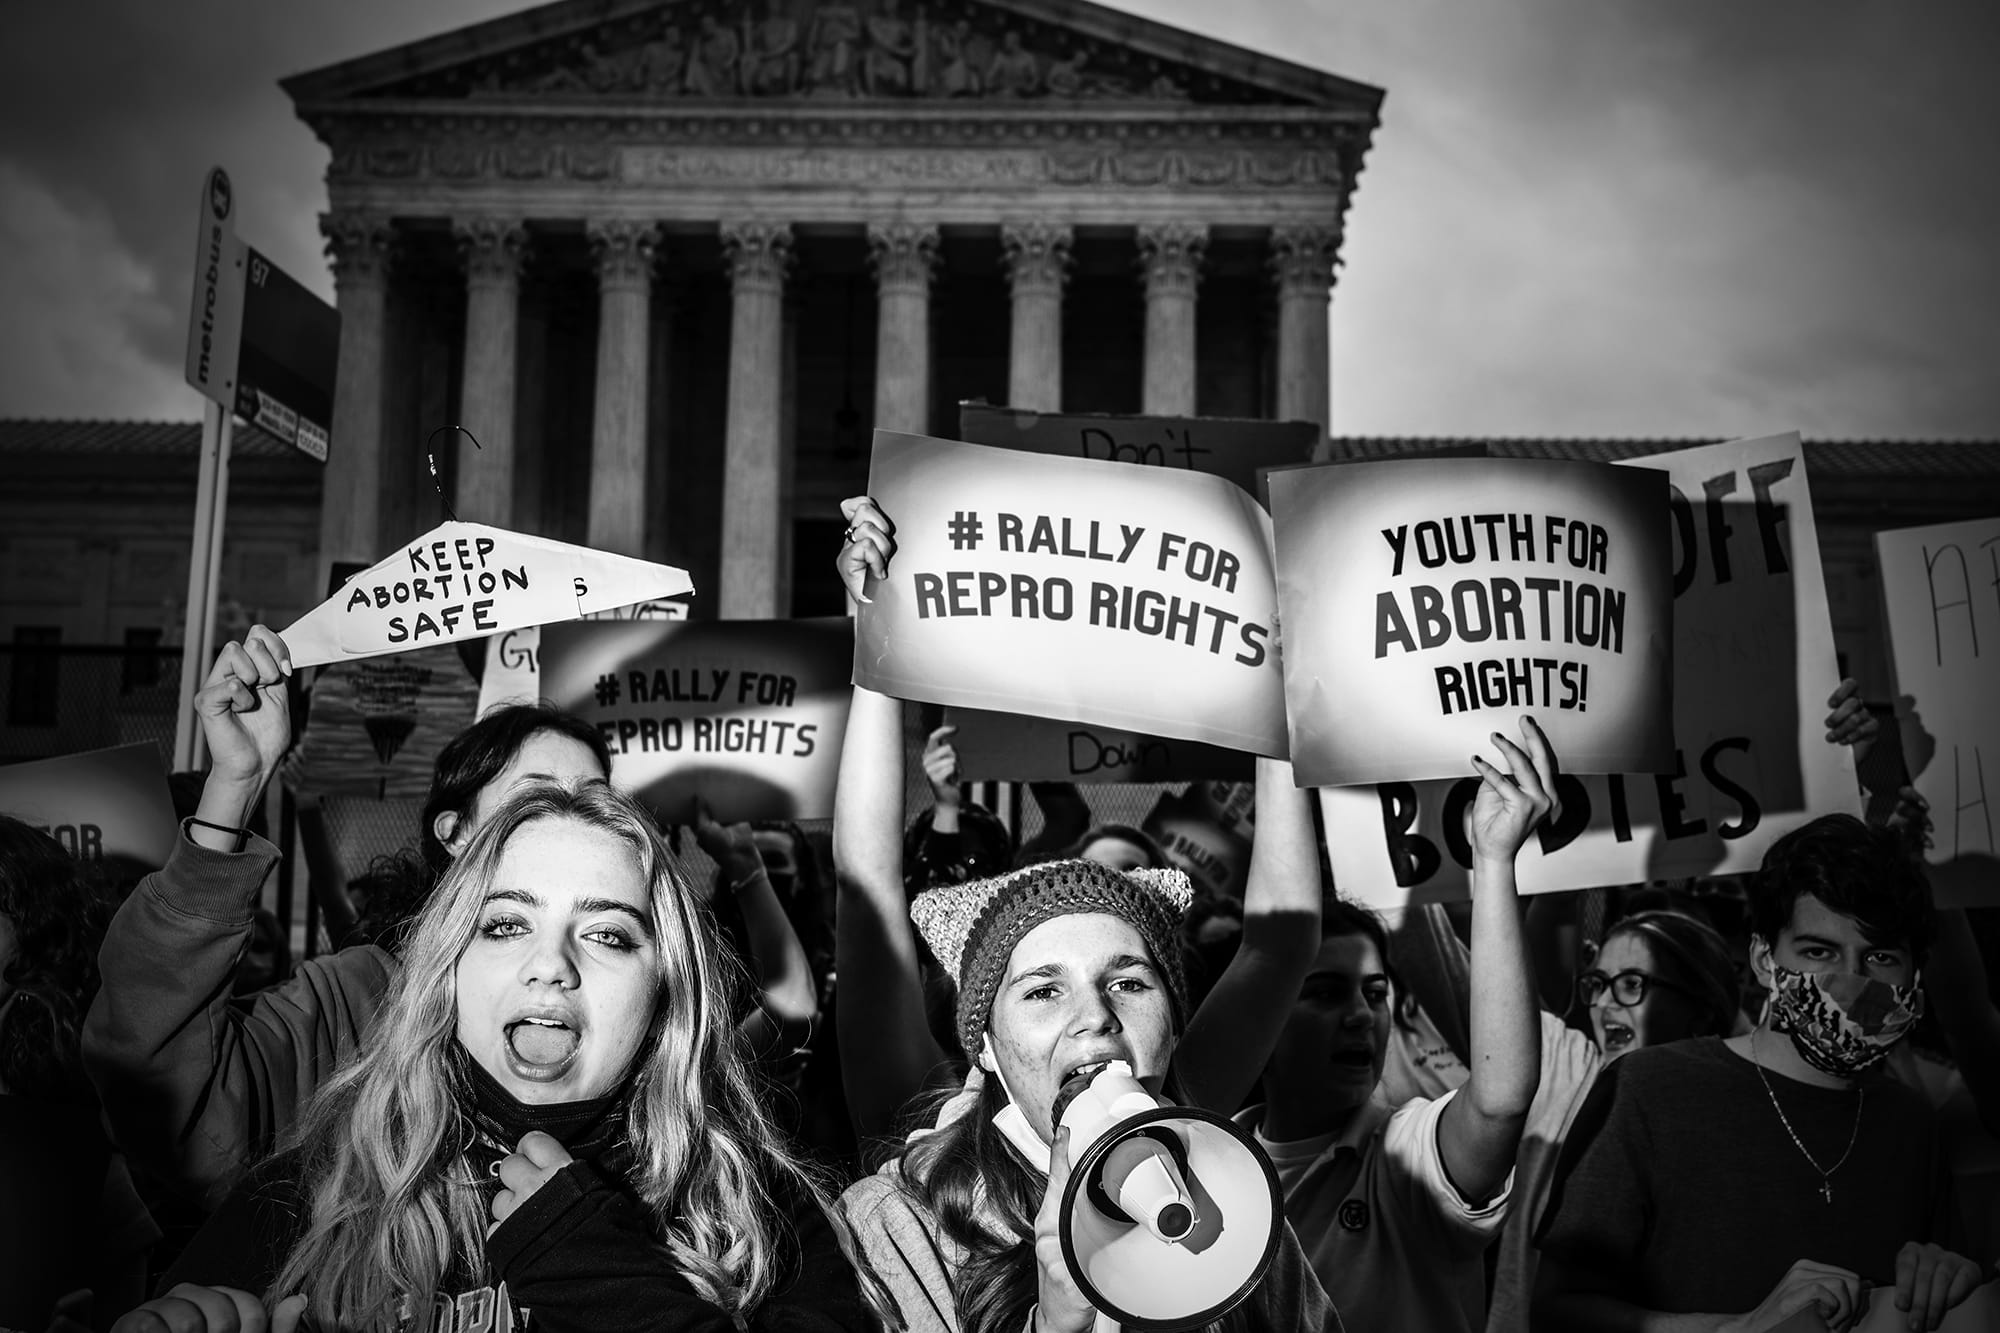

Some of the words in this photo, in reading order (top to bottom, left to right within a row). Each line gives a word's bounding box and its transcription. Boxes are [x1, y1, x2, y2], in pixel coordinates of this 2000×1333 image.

[250, 258, 270, 288] 97
[200, 223, 222, 383] metrobus
[408, 537, 495, 573] KEEP
[948, 511, 984, 551] #
[997, 512, 1146, 564] RALLY
[1156, 532, 1241, 594] FOR
[1381, 513, 1536, 577] YOUTH
[1545, 515, 1609, 575] FOR
[346, 565, 529, 613] ABORTION
[388, 599, 498, 643] SAFE
[913, 571, 1074, 621] REPRO
[1089, 582, 1269, 668] RIGHTS
[1374, 577, 1627, 660] ABORTION
[596, 674, 620, 706] #
[628, 669, 730, 704] RALLY
[738, 671, 798, 707] FOR
[1434, 657, 1589, 716] RIGHTS!
[598, 717, 683, 757] EPRO
[694, 719, 818, 758] RIGHTS
[1067, 730, 1171, 775] Down
